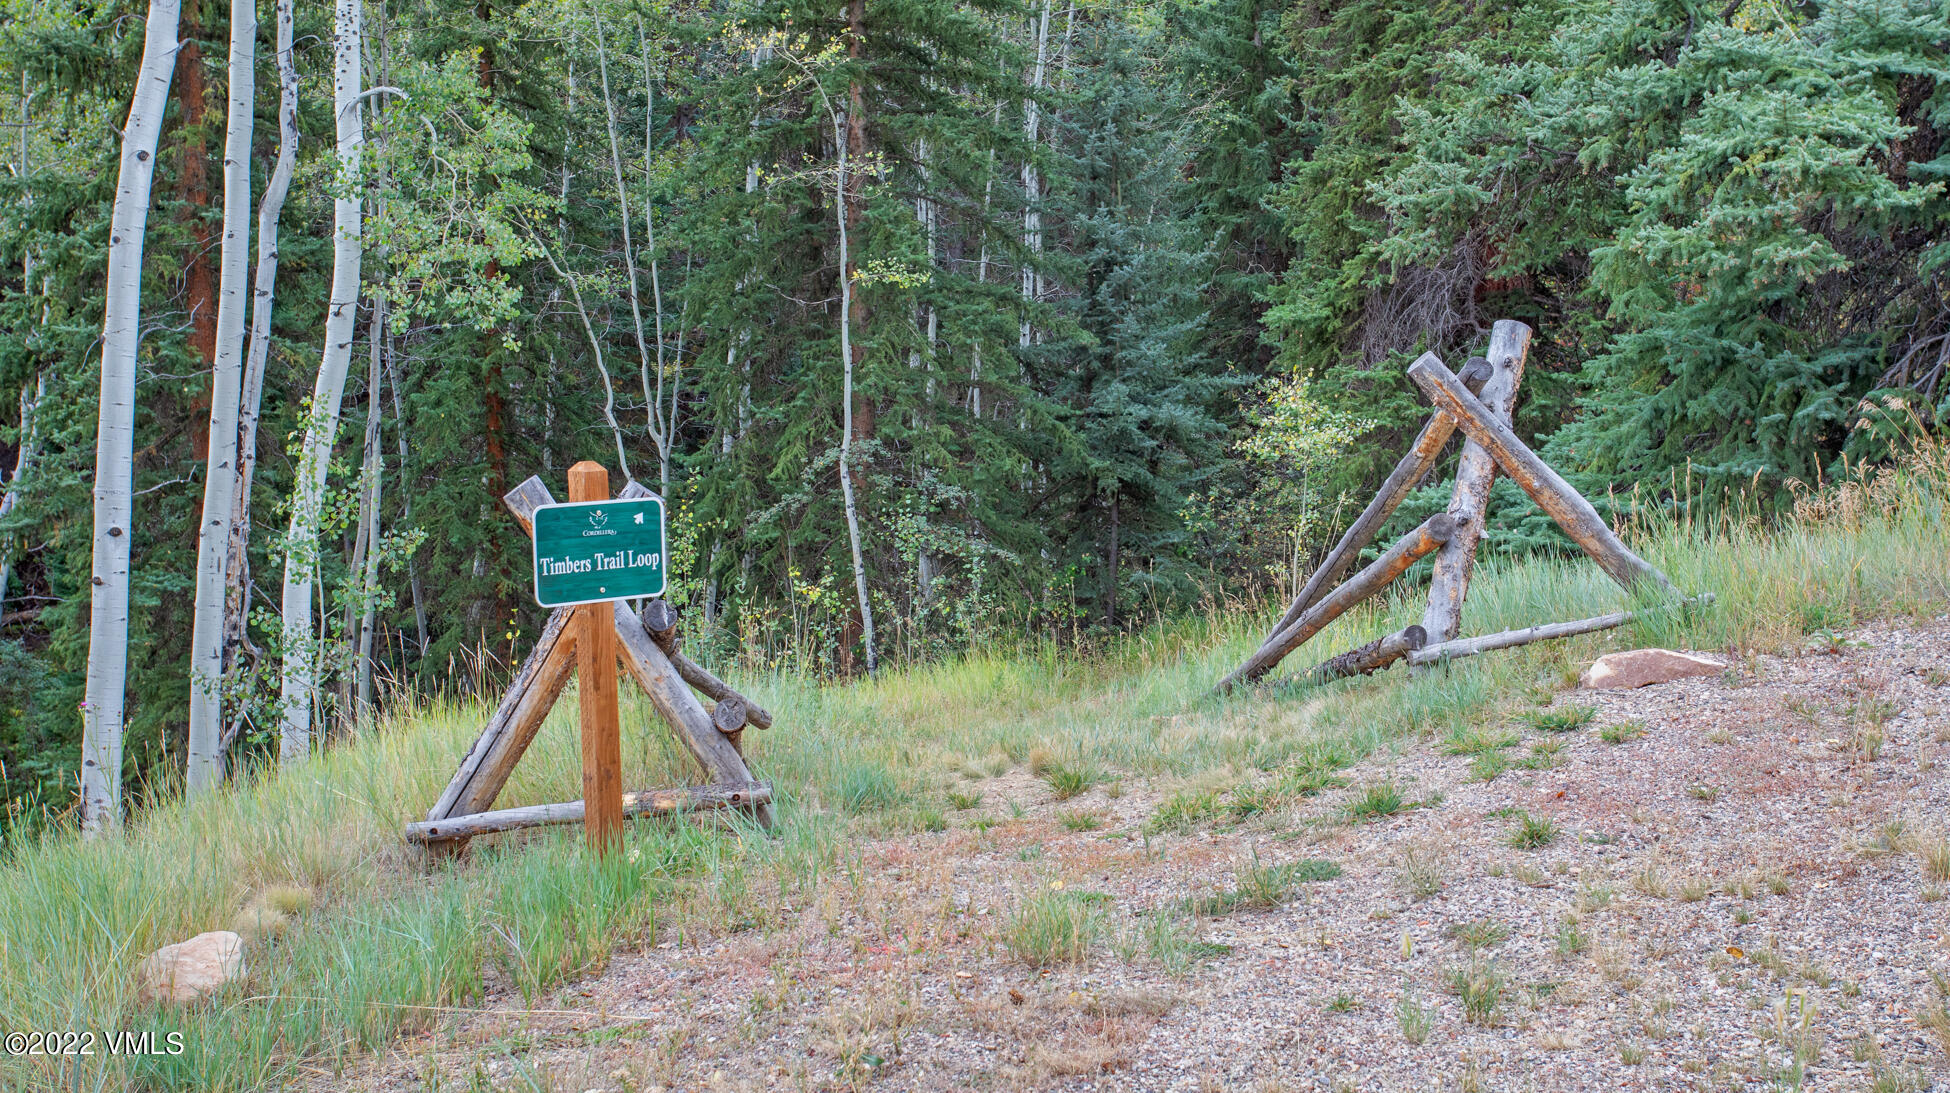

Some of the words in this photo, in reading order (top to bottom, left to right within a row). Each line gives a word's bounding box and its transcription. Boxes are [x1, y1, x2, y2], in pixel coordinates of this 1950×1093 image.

[540, 555, 592, 576] Timbers
[594, 551, 625, 571] Trail
[627, 550, 660, 570] Loop
